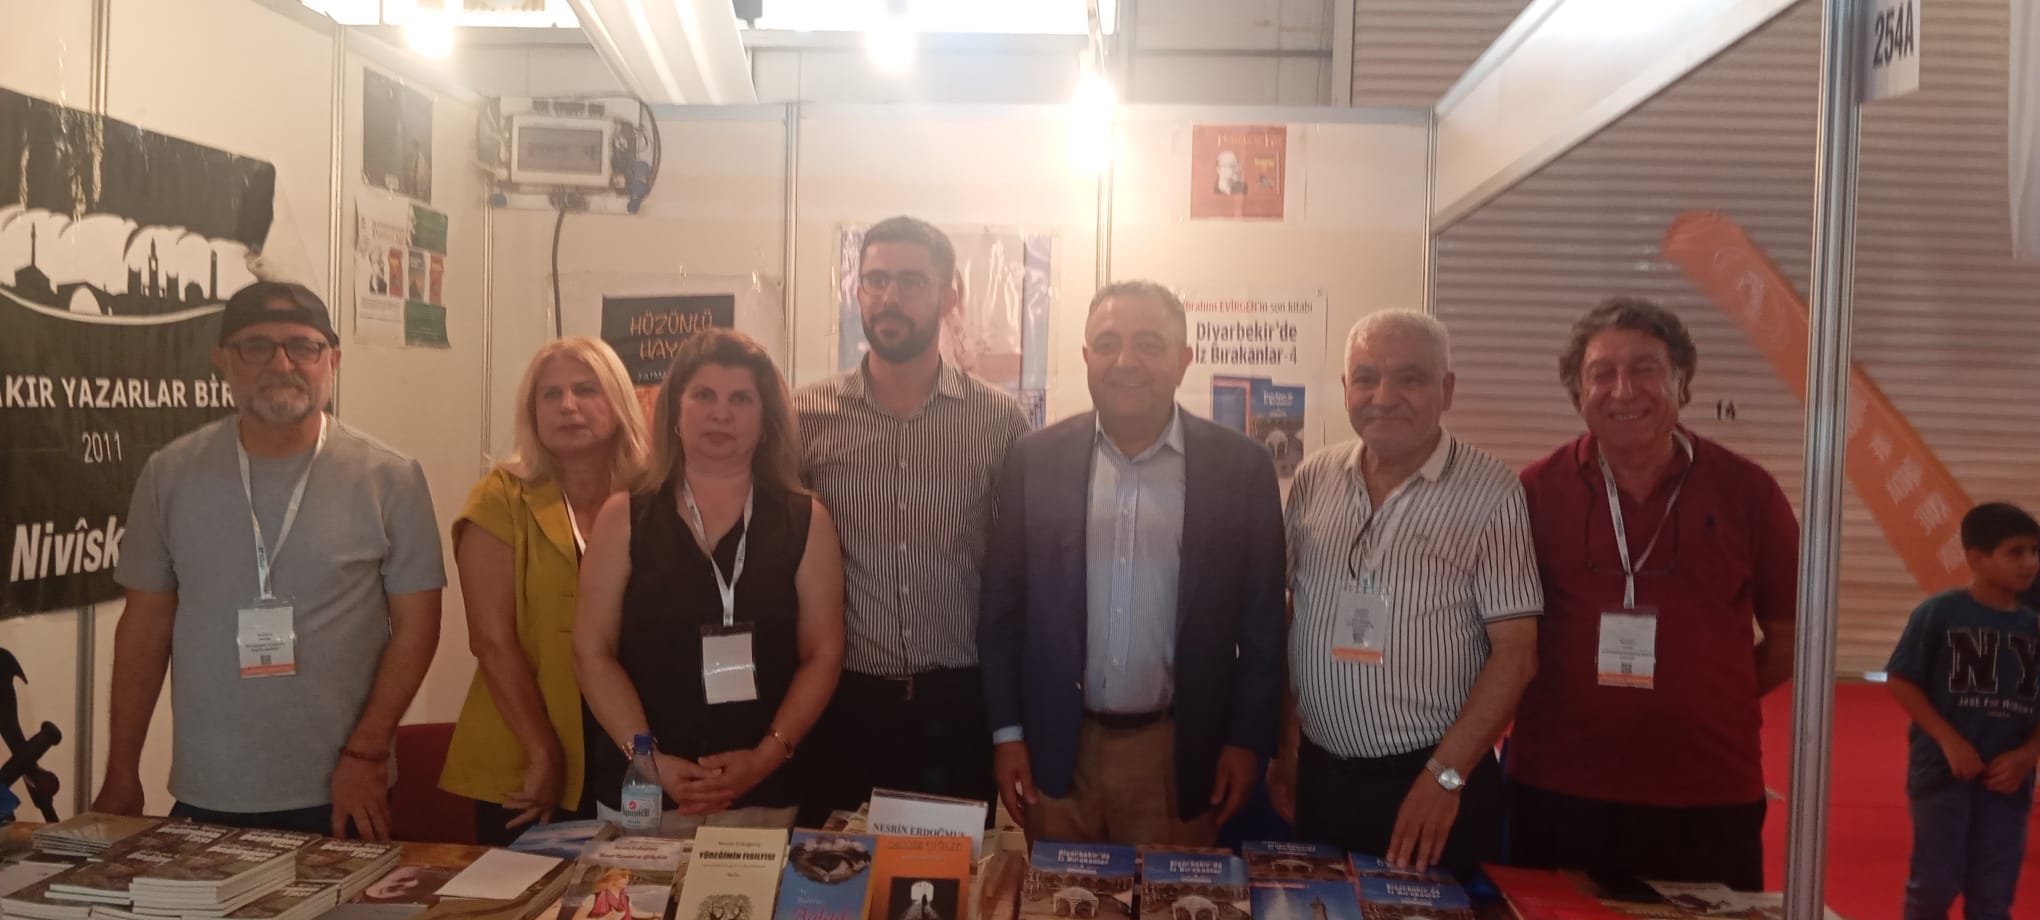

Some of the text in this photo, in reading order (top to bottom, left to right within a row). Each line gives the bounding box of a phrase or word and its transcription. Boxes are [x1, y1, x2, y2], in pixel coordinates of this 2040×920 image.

[1873, 0, 1914, 68] 254A
[0, 375, 56, 408] KIR
[61, 377, 188, 408] YAZARLAR
[82, 431, 123, 464] 2011
[10, 515, 125, 582] Nivîsk
[872, 823, 908, 834] NESRİN
